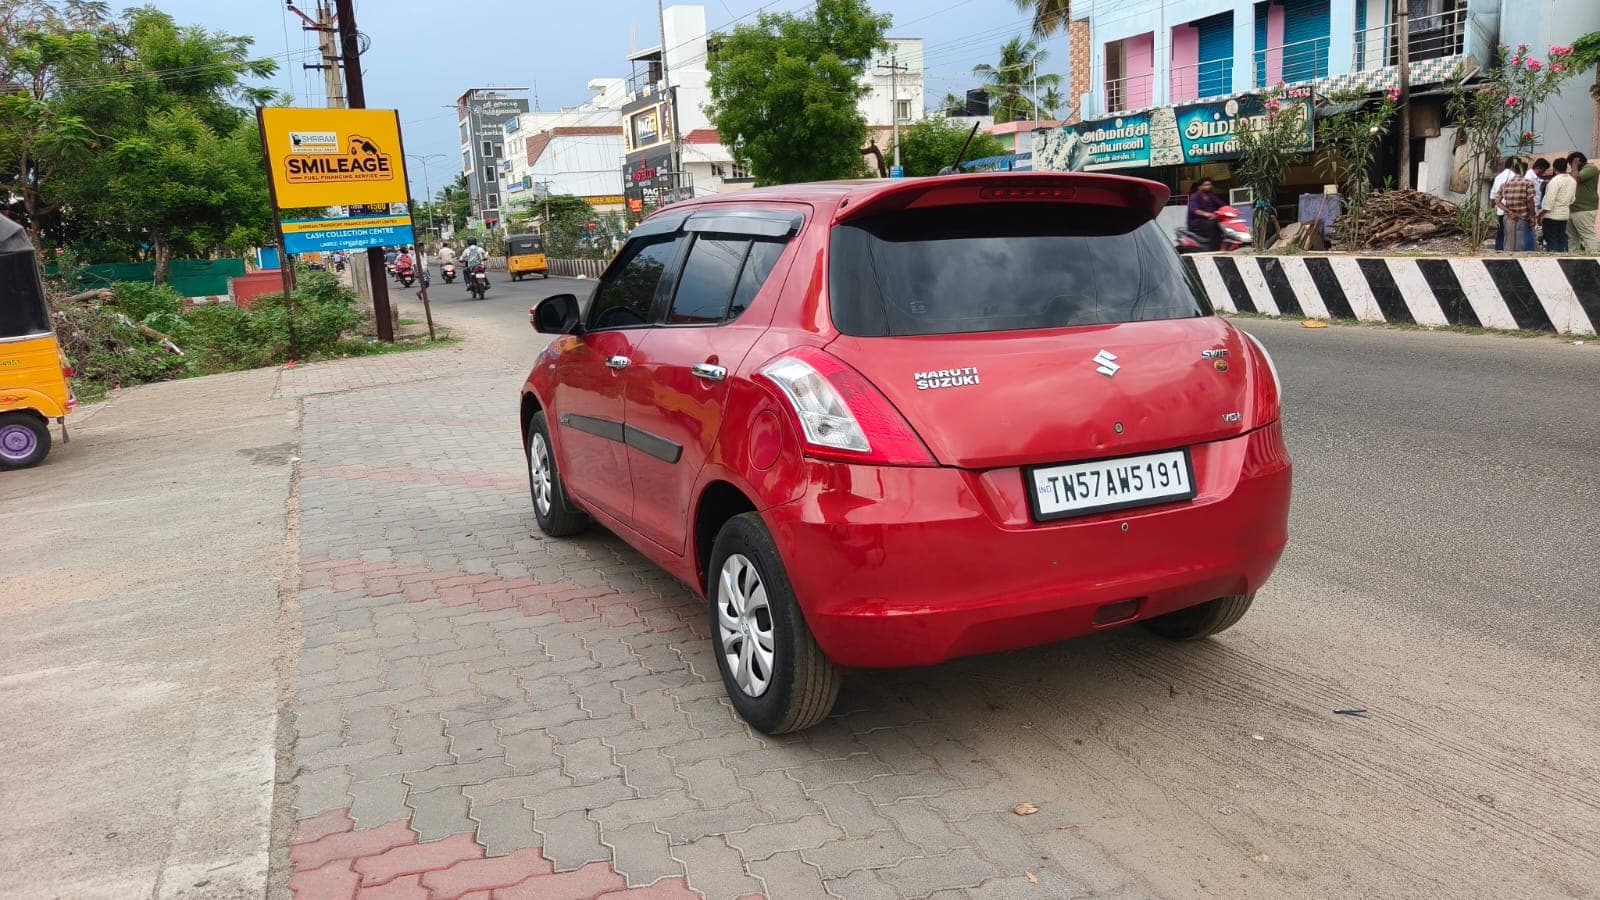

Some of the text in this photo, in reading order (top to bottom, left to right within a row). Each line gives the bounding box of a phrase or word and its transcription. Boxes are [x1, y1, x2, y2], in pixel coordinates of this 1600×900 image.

[288, 157, 390, 174] SMILEAGE
[305, 227, 394, 240] CASH COLLECTION CENTRE
[914, 367, 978, 380] MARUTI
[916, 375, 980, 390] SUZUKI
[1048, 460, 1183, 504] TN57AW5191
